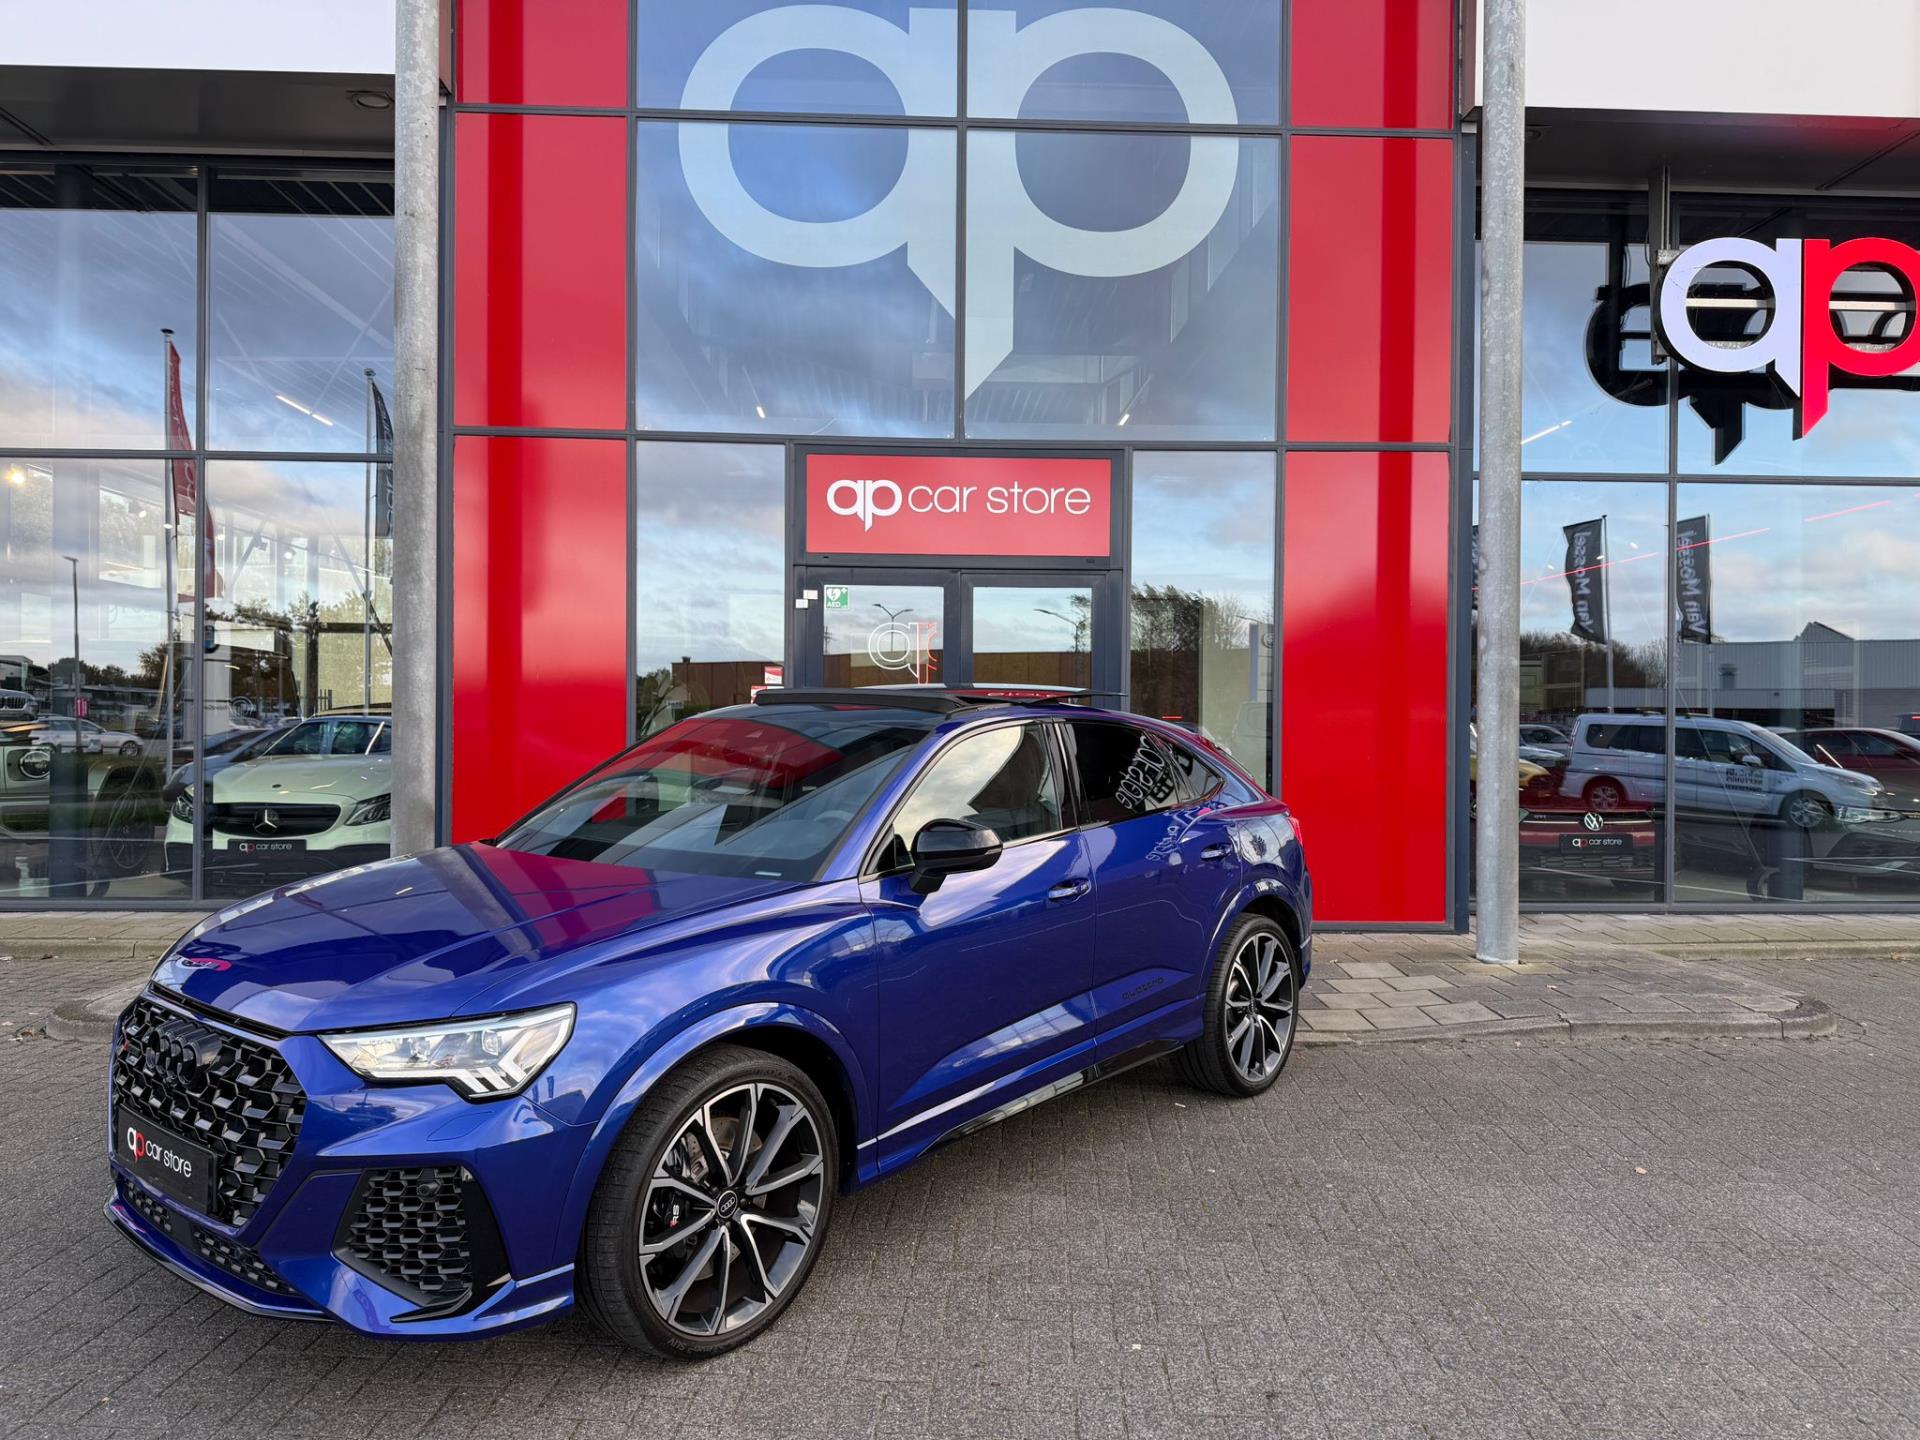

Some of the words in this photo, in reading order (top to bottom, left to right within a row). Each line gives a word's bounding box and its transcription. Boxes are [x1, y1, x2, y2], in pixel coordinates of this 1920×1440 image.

[679, 4, 1239, 400] ap
[826, 479, 902, 532] ap
[908, 485, 977, 513] car
[986, 481, 1091, 514] store
[826, 601, 841, 609] AED
[256, 843, 269, 851] car
[270, 842, 292, 851] store
[1589, 838, 1602, 846] car
[1603, 837, 1623, 847] store
[145, 1140, 162, 1161] car
[163, 1149, 192, 1177] store
